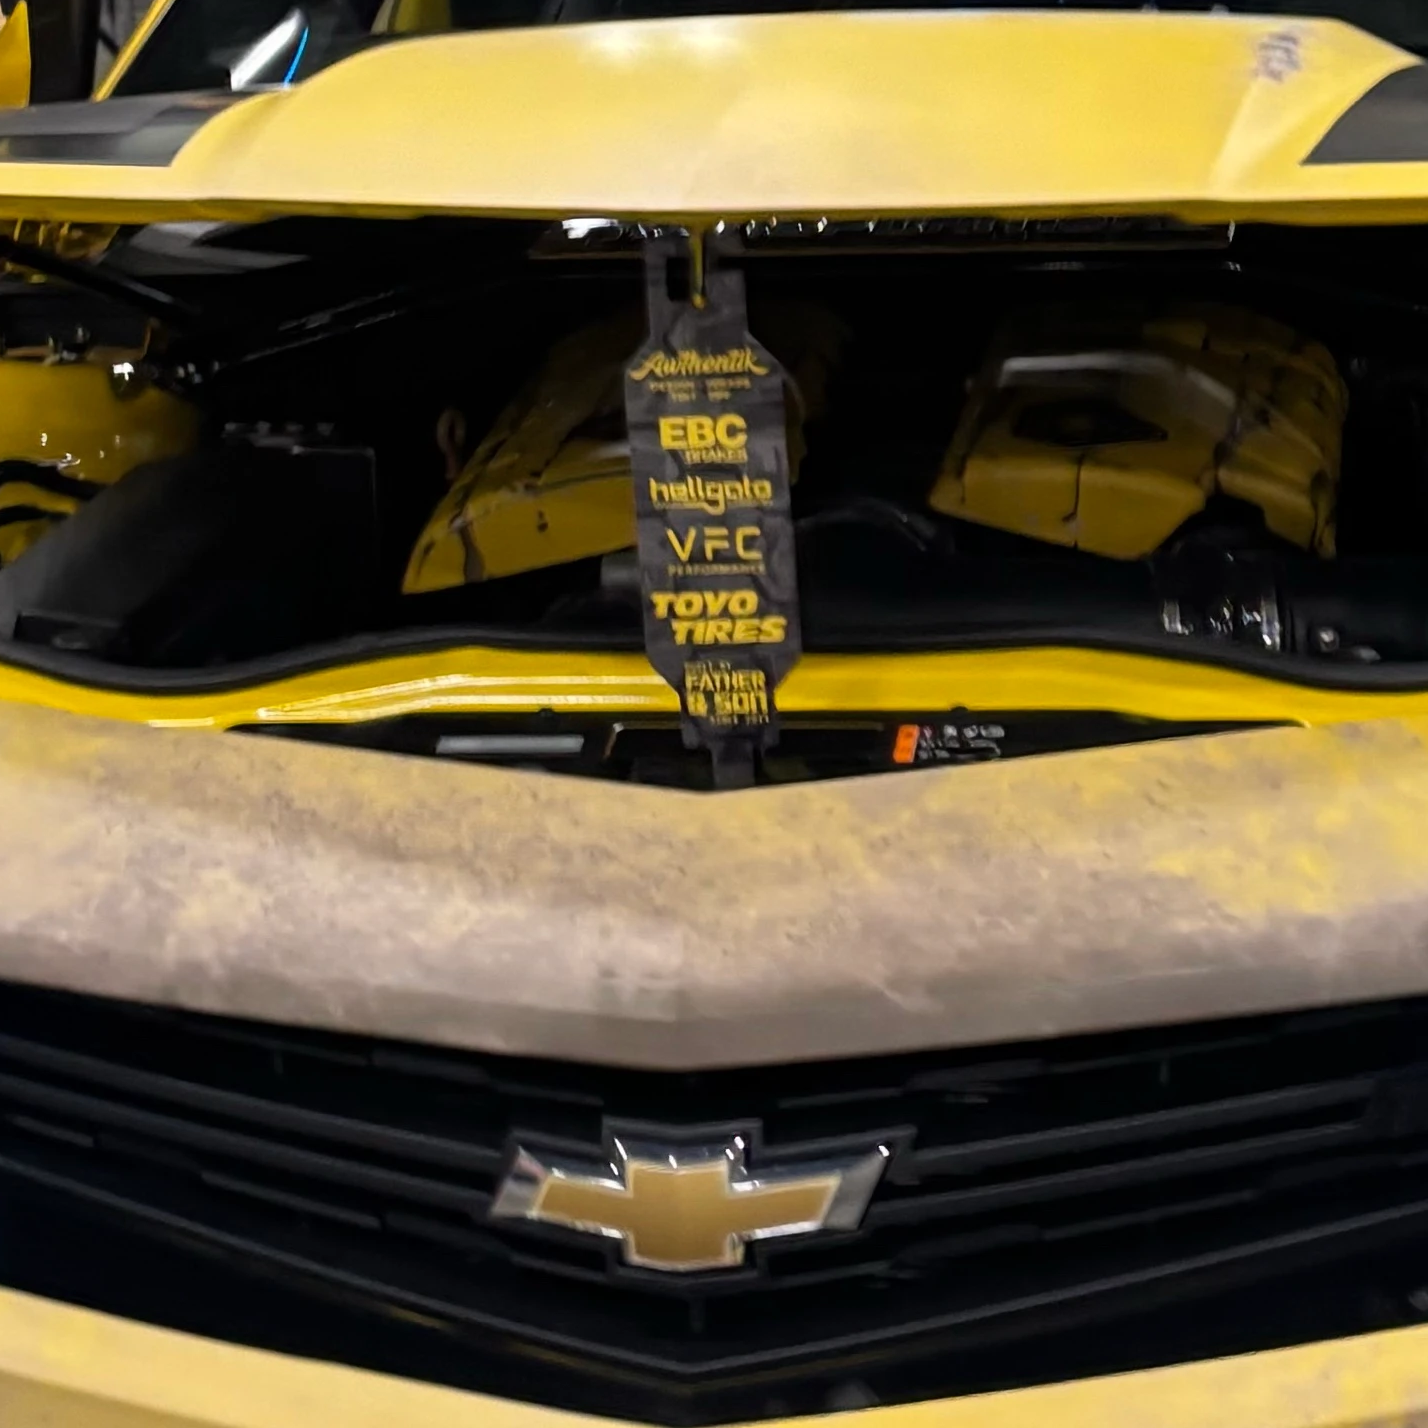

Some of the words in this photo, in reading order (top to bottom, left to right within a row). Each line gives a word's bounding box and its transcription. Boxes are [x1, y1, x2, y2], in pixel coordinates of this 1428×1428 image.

[658, 413, 747, 451] EBC
[666, 525, 764, 562] VFC
[651, 589, 759, 619] TOYO
[671, 615, 788, 646] TIRES
